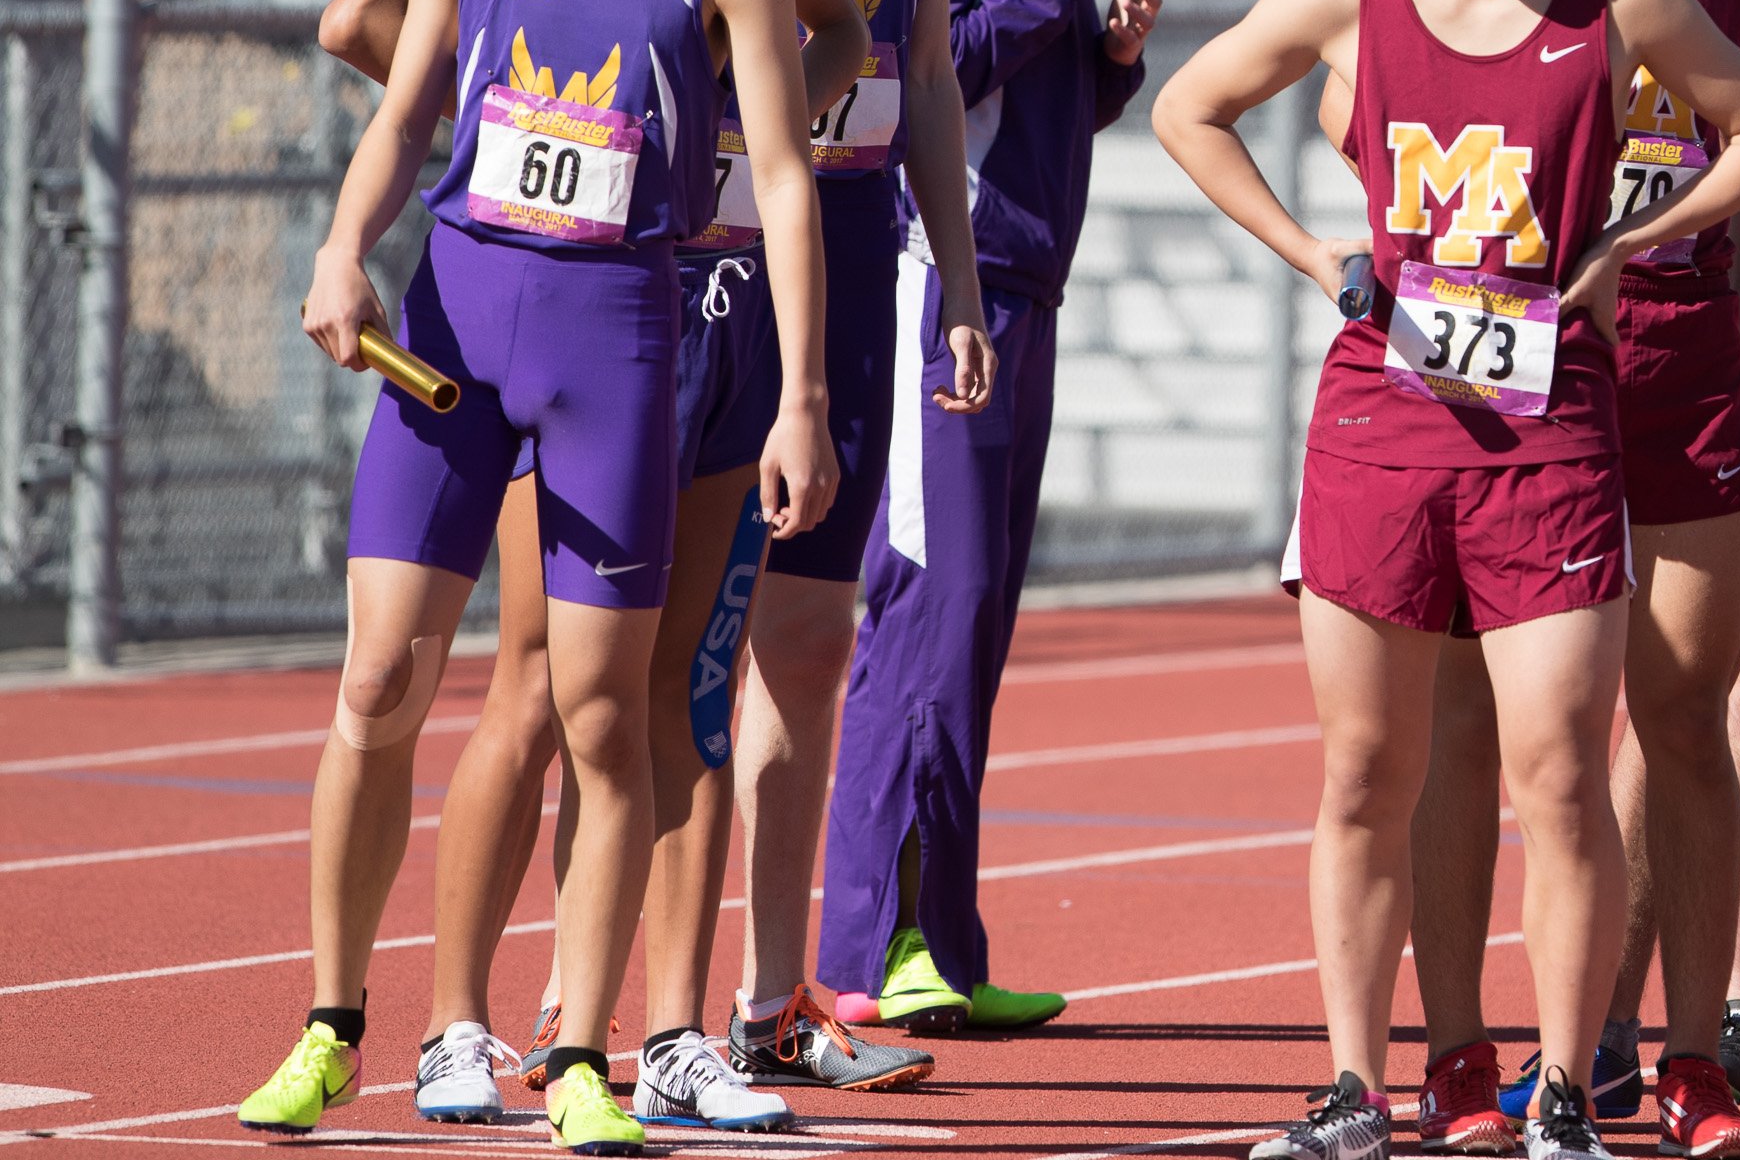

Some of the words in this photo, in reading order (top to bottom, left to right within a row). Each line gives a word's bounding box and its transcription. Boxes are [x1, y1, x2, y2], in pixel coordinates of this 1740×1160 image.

[507, 101, 615, 141] RustBuster
[810, 145, 856, 158] UGURAL
[1624, 138, 1684, 158] Buster
[518, 140, 582, 206] 60
[1385, 121, 1551, 269] MA
[501, 201, 578, 229] INAUGURAL
[1423, 310, 1517, 381] 373
[1423, 374, 1502, 400] INAUGURAL
[1337, 416, 1371, 426] DRI-FIT
[693, 562, 757, 702] USA
